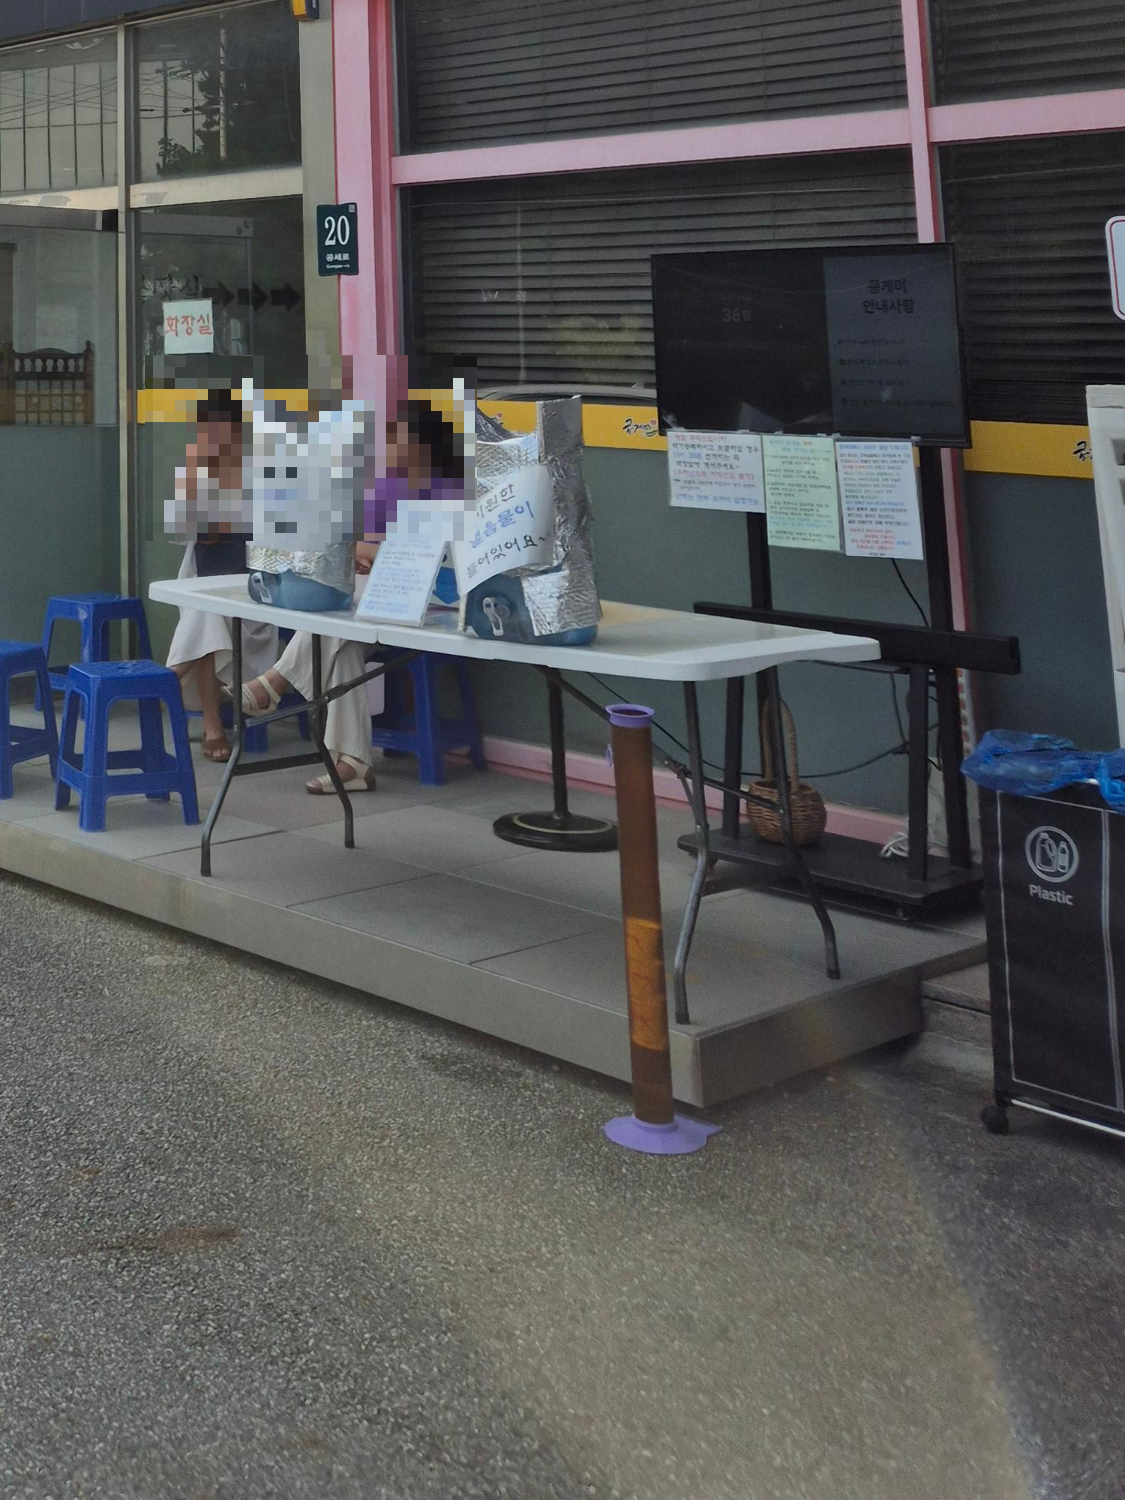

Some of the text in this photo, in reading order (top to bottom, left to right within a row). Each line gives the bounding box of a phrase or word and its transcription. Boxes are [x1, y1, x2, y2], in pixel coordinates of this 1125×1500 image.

[324, 215, 350, 246] 20
[325, 253, 350, 262] 공세로
[867, 279, 907, 294] 콩게미
[863, 299, 915, 314] 안내사항
[165, 313, 213, 337] 화장실
[1028, 884, 1074, 905] Plastic
